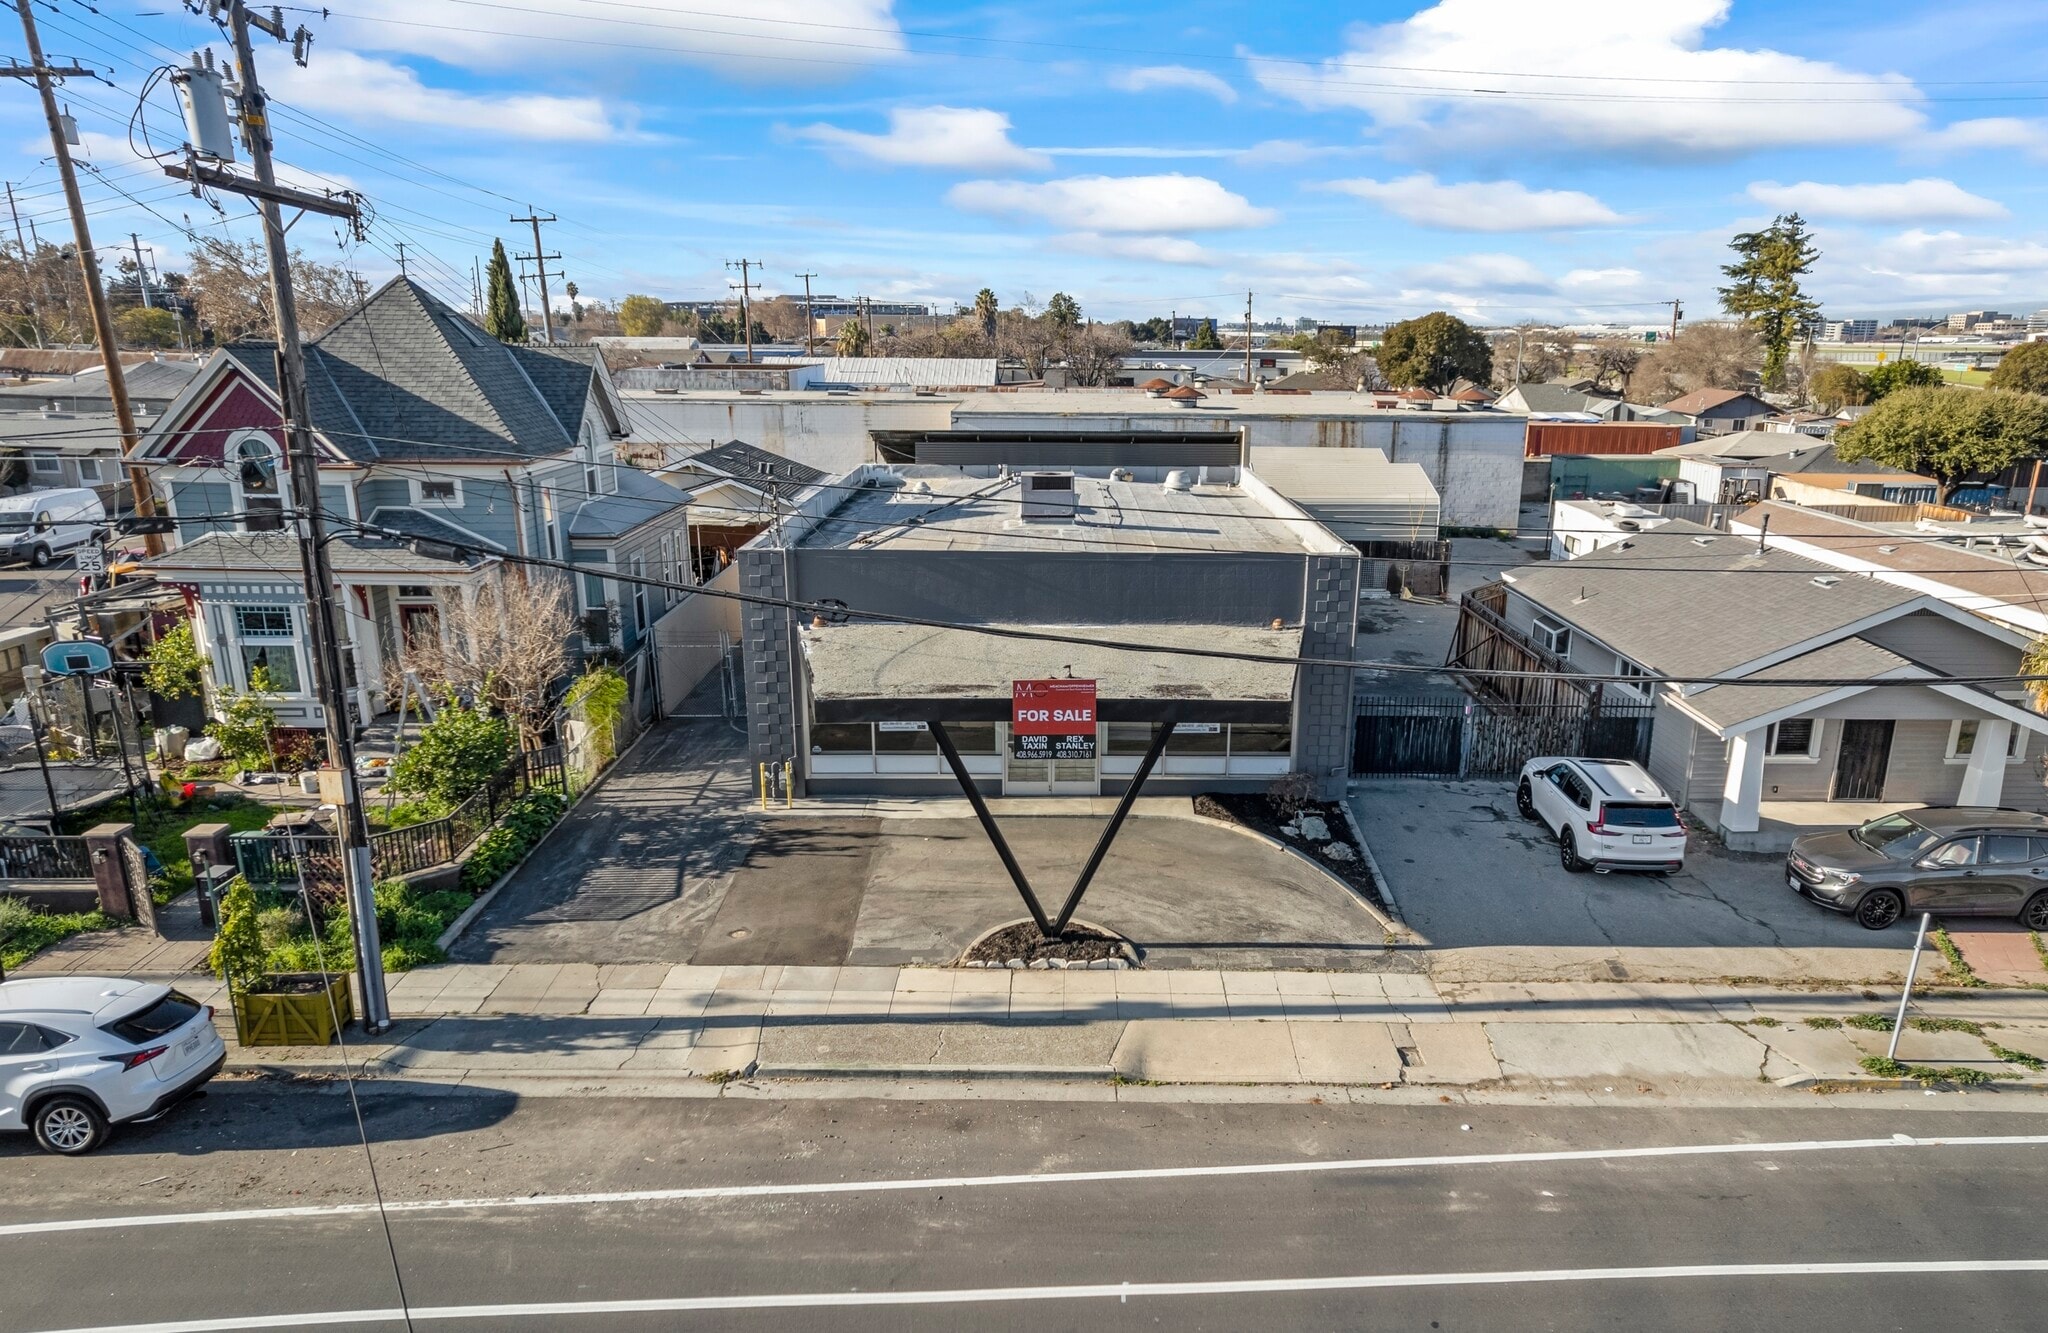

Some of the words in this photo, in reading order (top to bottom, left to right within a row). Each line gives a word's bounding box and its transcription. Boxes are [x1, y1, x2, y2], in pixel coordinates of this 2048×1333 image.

[80, 561, 101, 571] 25
[1018, 709, 1049, 722] FOR
[1053, 709, 1092, 722] SALE
[1022, 735, 1048, 743] DAVID
[1066, 735, 1084, 743] REX
[1055, 742, 1095, 750] STANLEY
[1016, 750, 1053, 759] 408.966.5919
[1056, 750, 1092, 759] 408.310.7161
